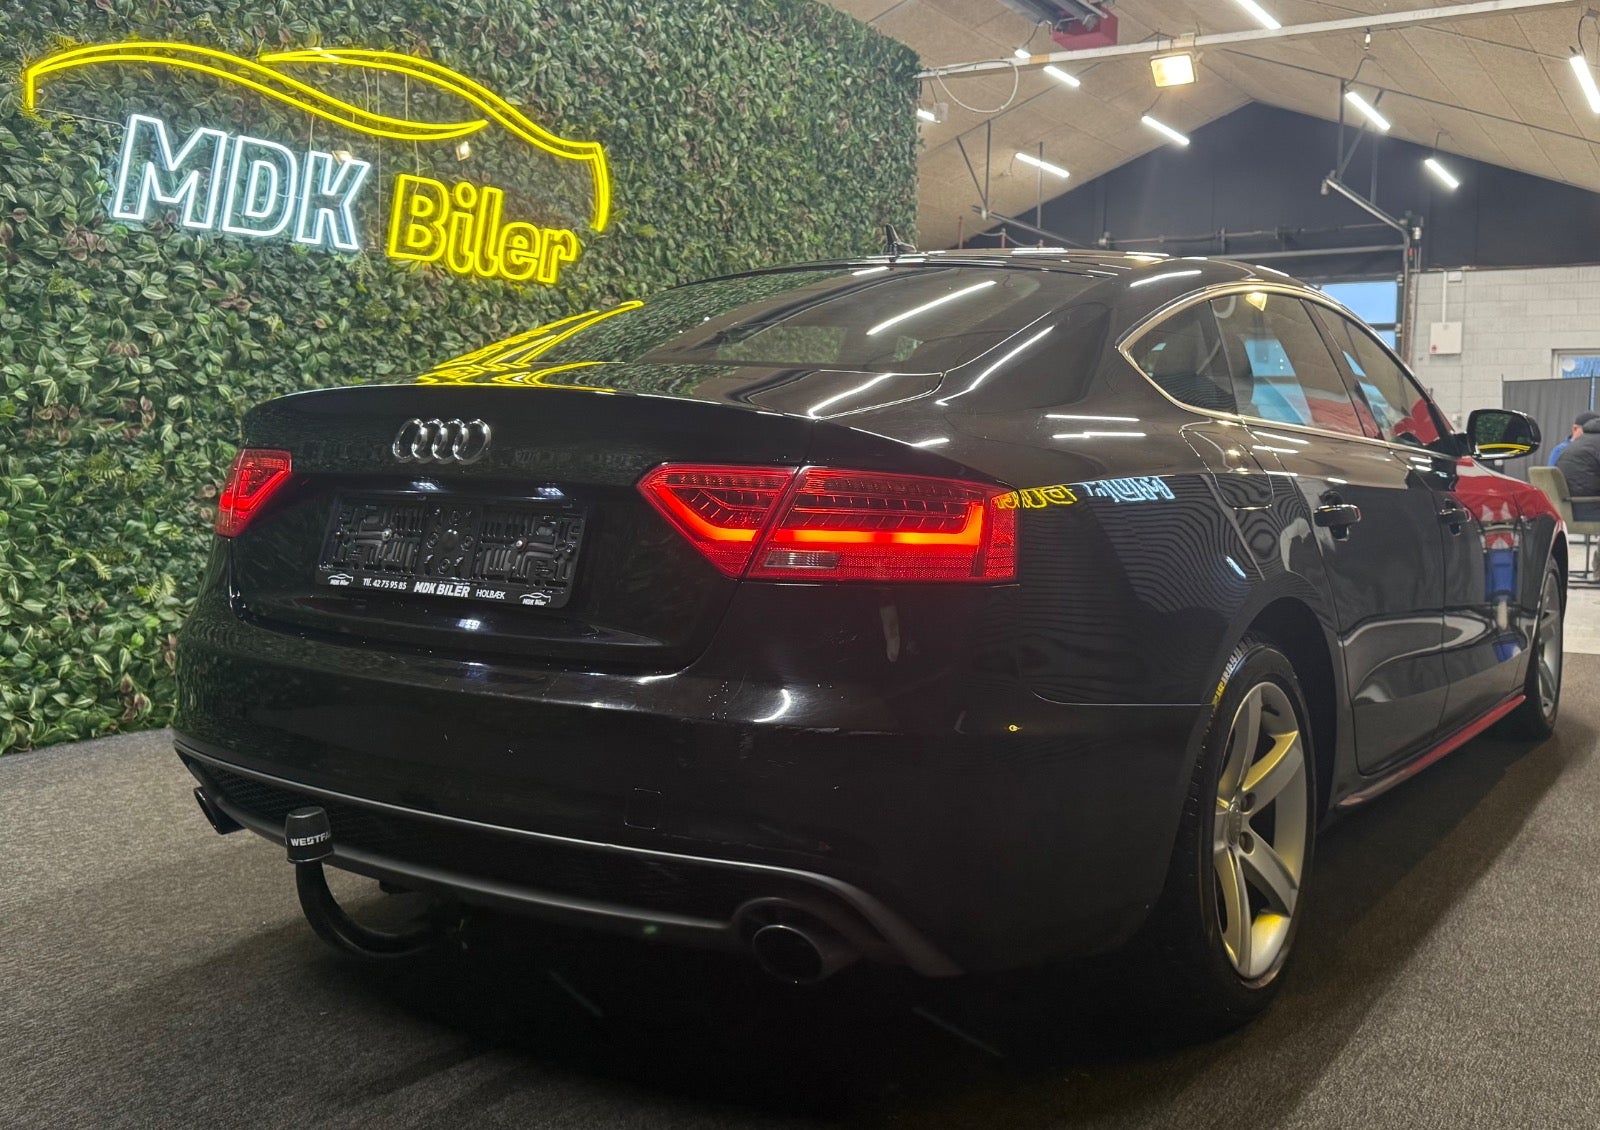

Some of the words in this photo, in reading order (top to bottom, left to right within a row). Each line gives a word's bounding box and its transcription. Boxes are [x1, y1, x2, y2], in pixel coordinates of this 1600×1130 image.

[112, 113, 371, 251] MDK
[386, 173, 579, 285] Biler
[372, 579, 382, 588] 42
[390, 581, 398, 589] 95
[413, 582, 437, 594] MDK
[436, 583, 471, 598] BILER
[475, 588, 506, 600] HOLBÆK
